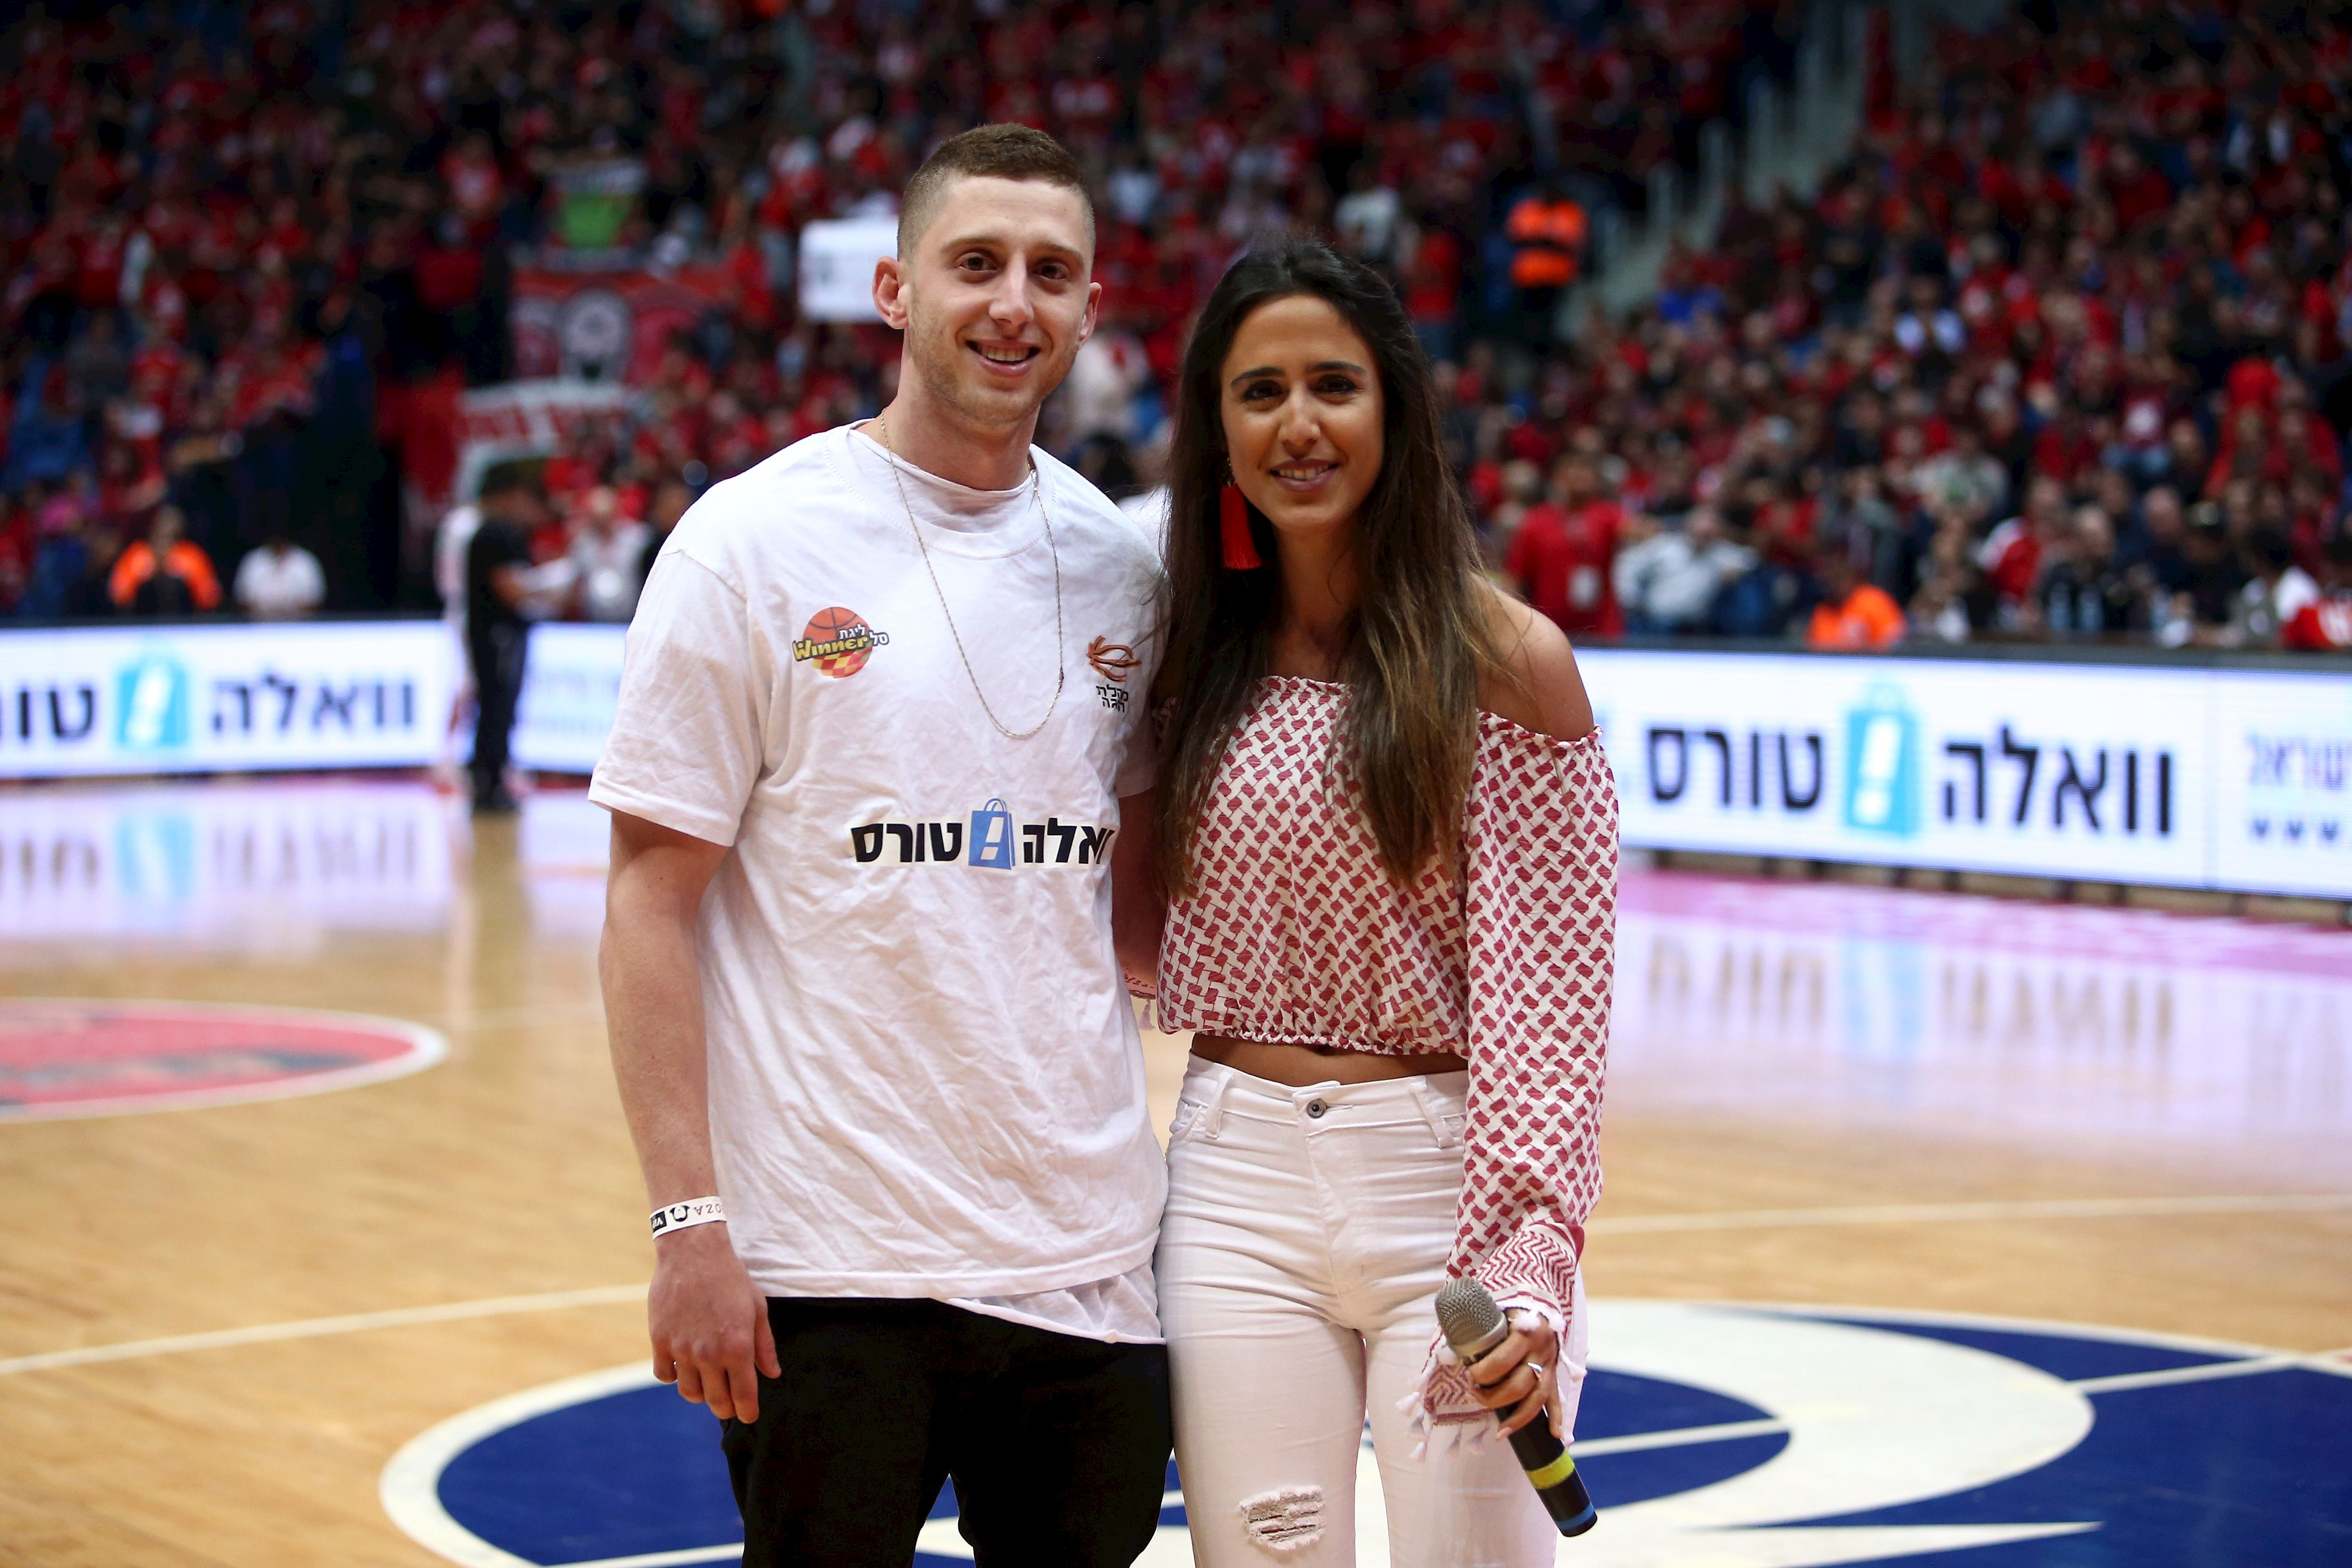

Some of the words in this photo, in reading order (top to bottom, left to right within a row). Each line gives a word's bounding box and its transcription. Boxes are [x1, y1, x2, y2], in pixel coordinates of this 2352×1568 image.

[793, 637, 868, 660] Winner
[839, 624, 866, 640] ליגת
[869, 631, 888, 645] סל
[0, 687, 93, 740] טו
[210, 673, 413, 733] וואלה
[1647, 727, 1823, 810] טורס
[1942, 725, 2173, 835] וואלה
[851, 823, 962, 863] טורס
